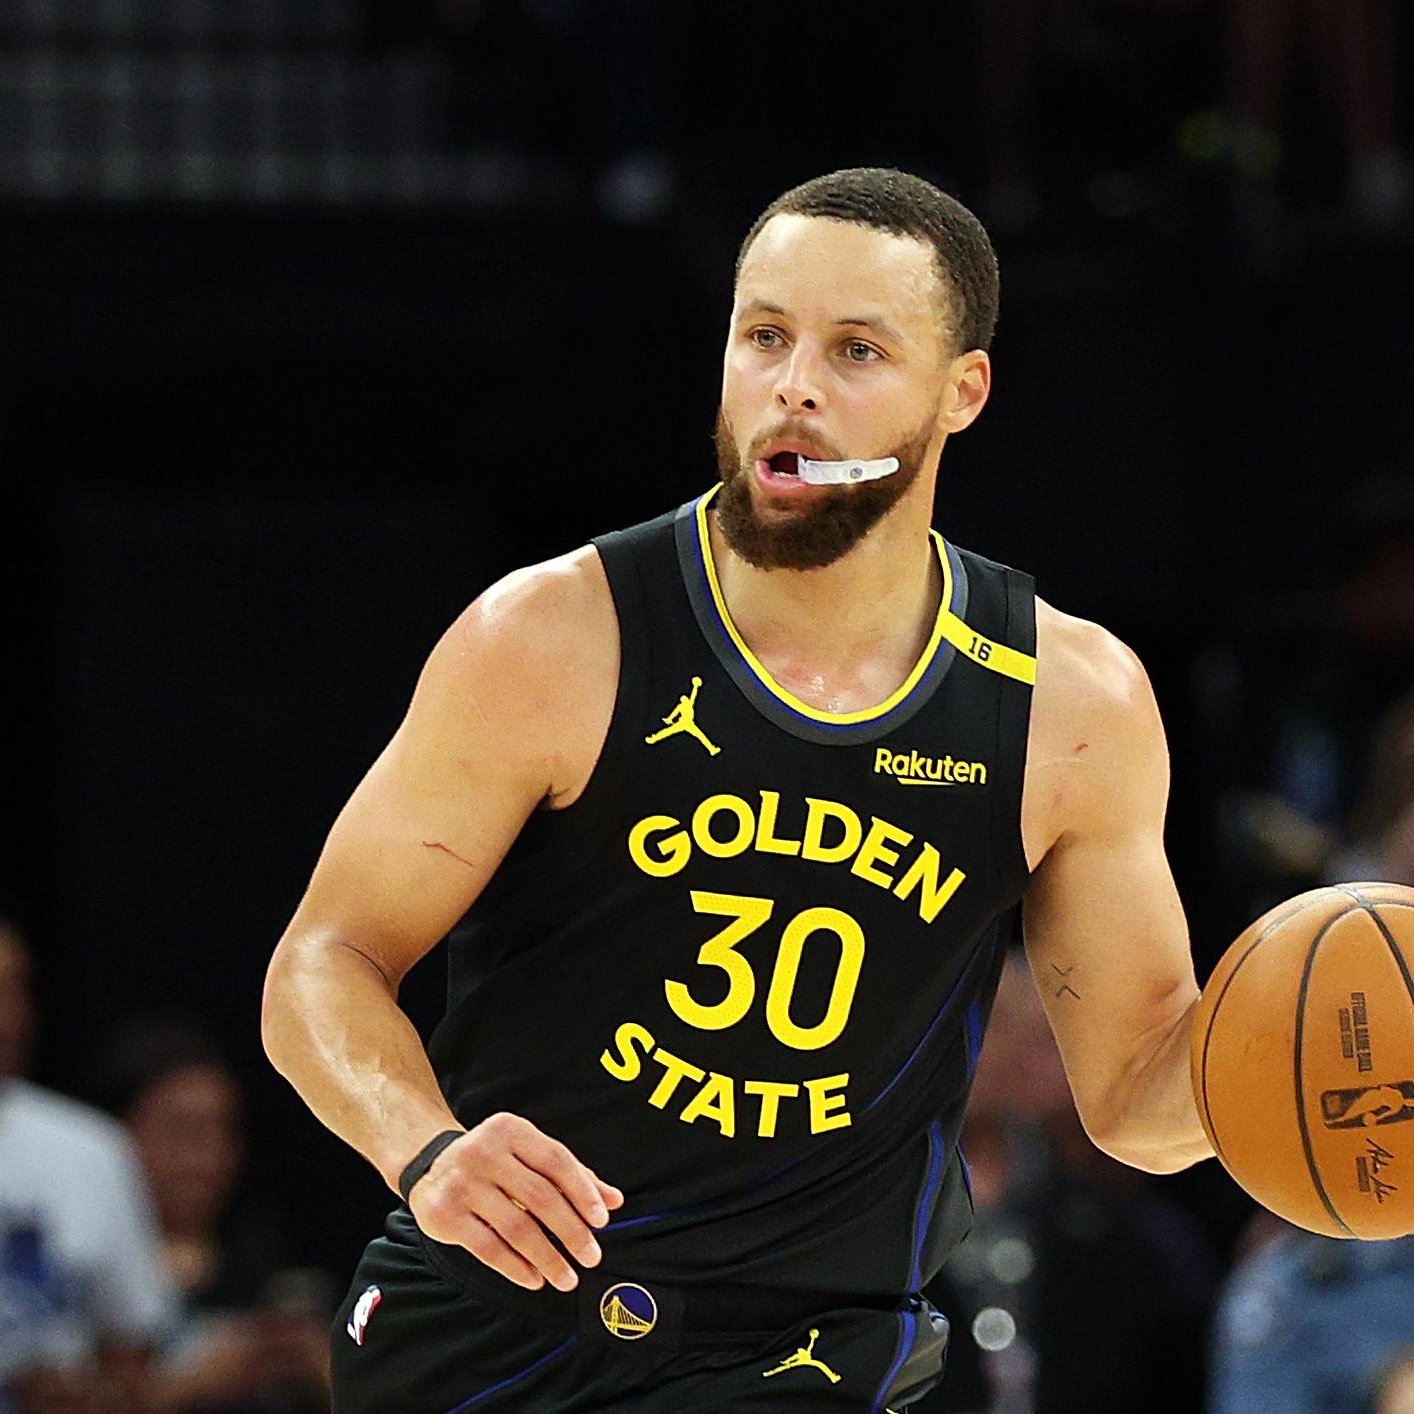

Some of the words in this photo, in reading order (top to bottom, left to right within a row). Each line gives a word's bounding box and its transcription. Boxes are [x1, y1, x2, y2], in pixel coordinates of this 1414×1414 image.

[968, 636, 993, 662] 16
[873, 747, 988, 785] Rakuten
[627, 789, 967, 924] GOLDEN
[663, 889, 866, 1052] 30
[598, 1021, 852, 1138] STATE
